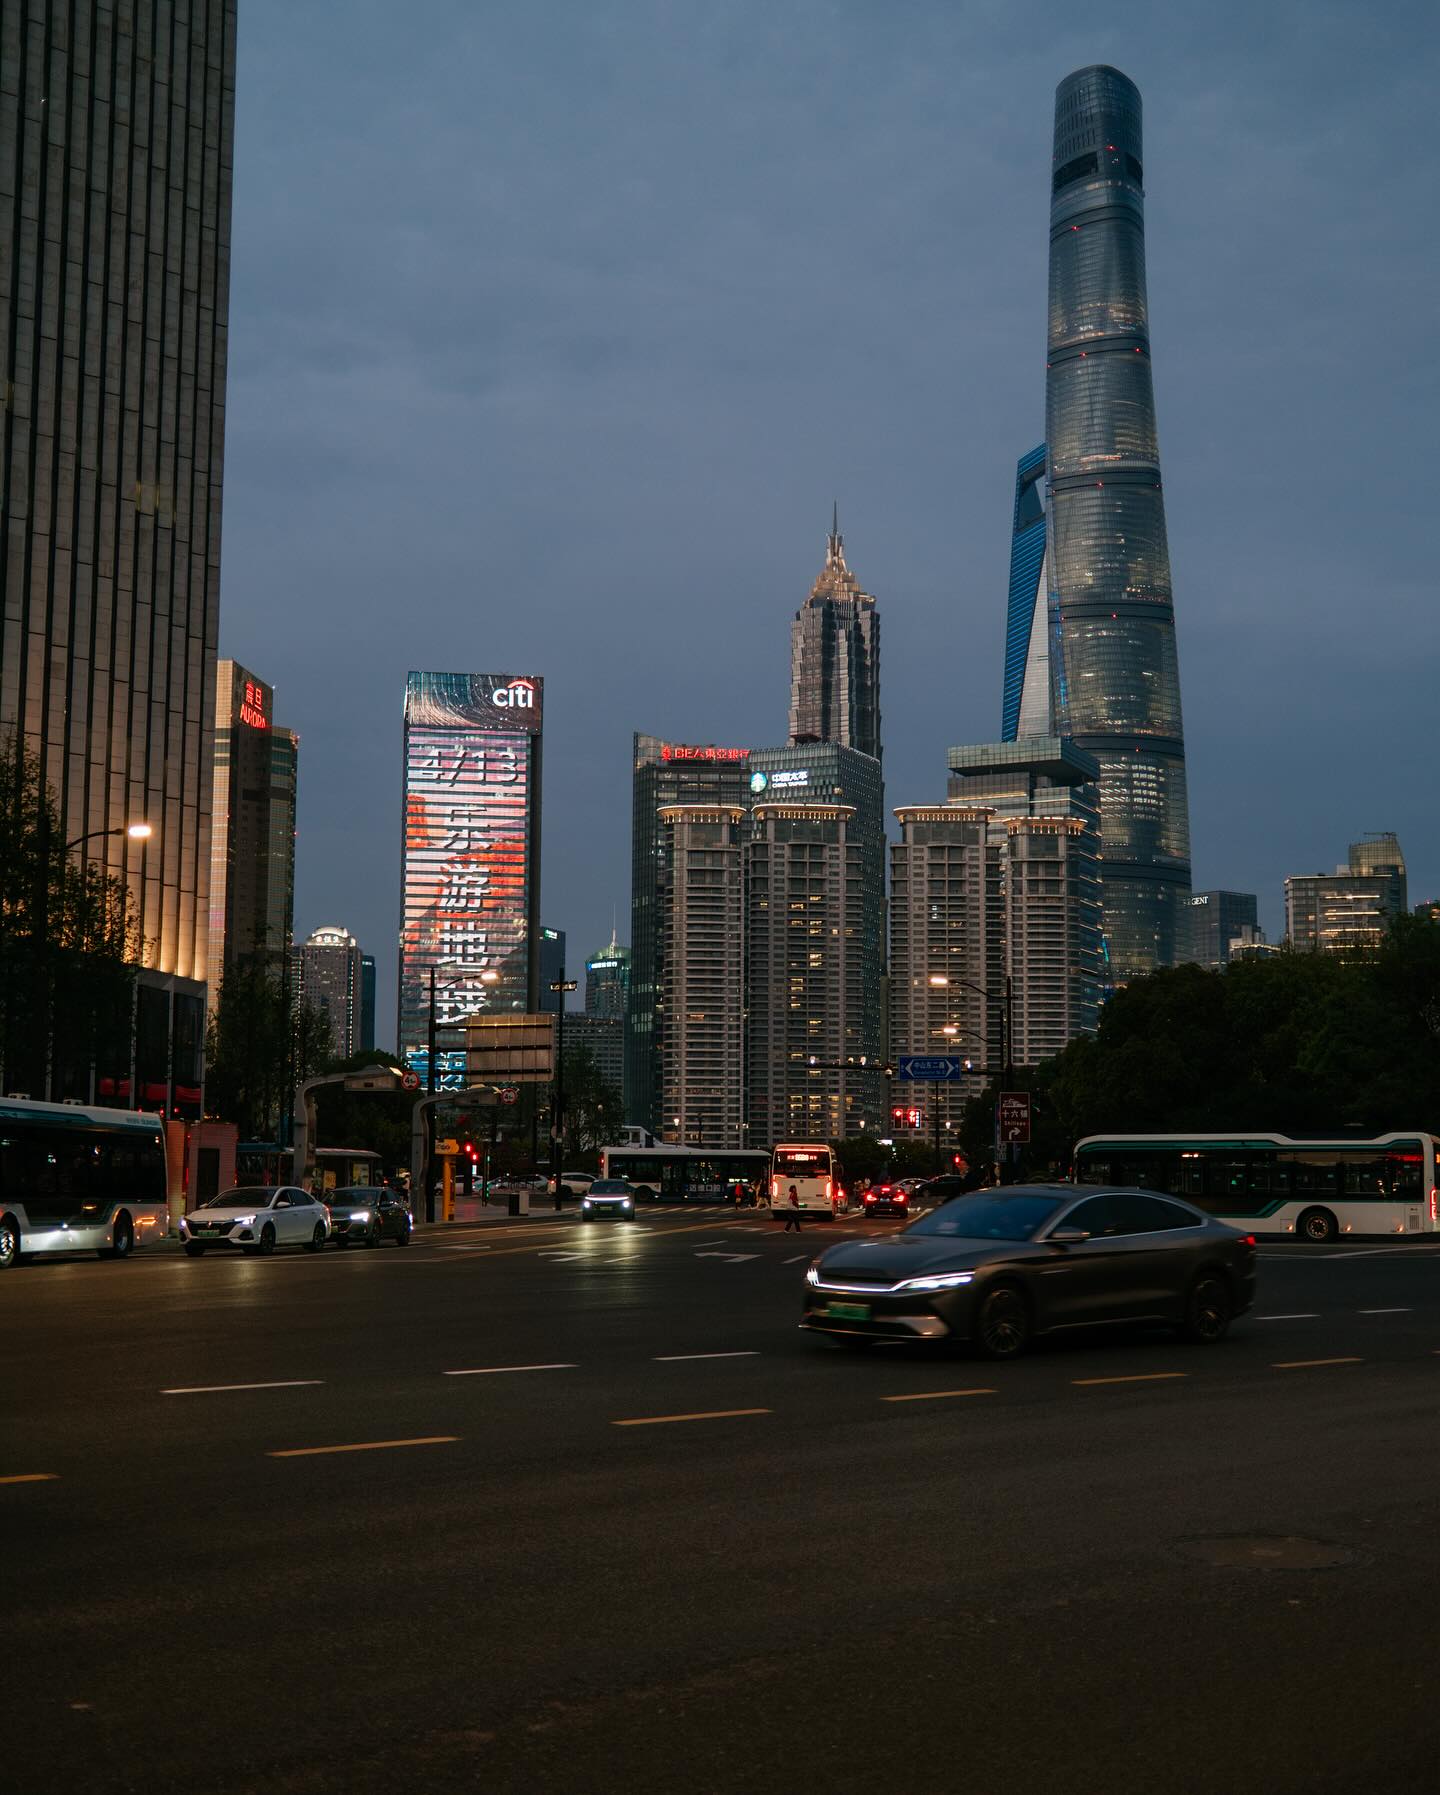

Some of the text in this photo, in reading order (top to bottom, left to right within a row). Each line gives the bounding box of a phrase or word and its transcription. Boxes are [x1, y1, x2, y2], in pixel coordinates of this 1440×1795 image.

[245, 681, 262, 710] 震旦
[492, 682, 534, 708] citi
[240, 704, 266, 729] AURORA
[420, 749, 518, 786] 4/13
